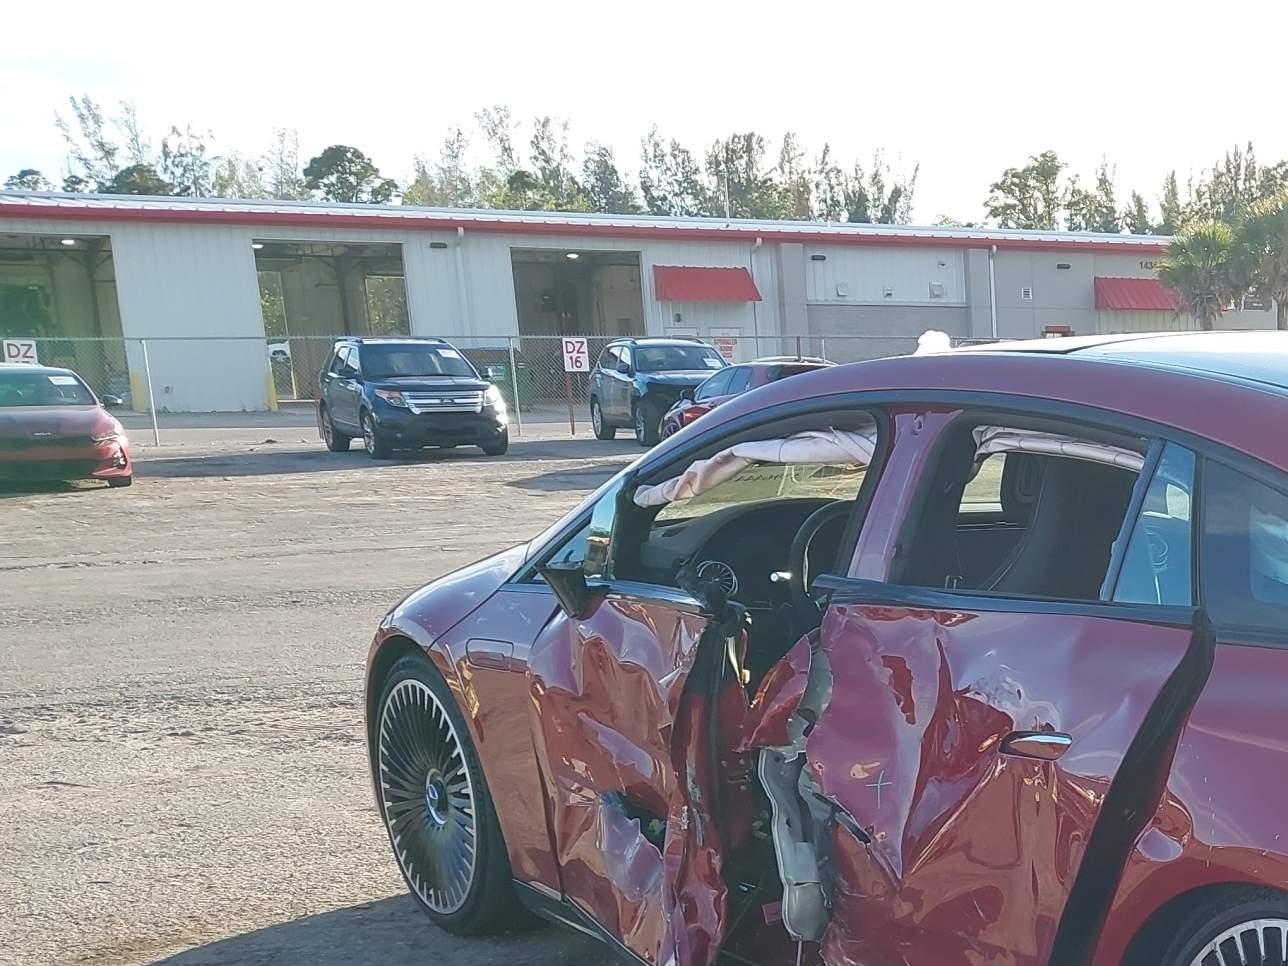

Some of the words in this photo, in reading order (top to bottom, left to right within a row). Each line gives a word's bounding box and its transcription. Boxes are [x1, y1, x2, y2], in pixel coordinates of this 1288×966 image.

[7, 343, 34, 358] DZ
[565, 341, 586, 354] DZ
[569, 356, 583, 369] 16
